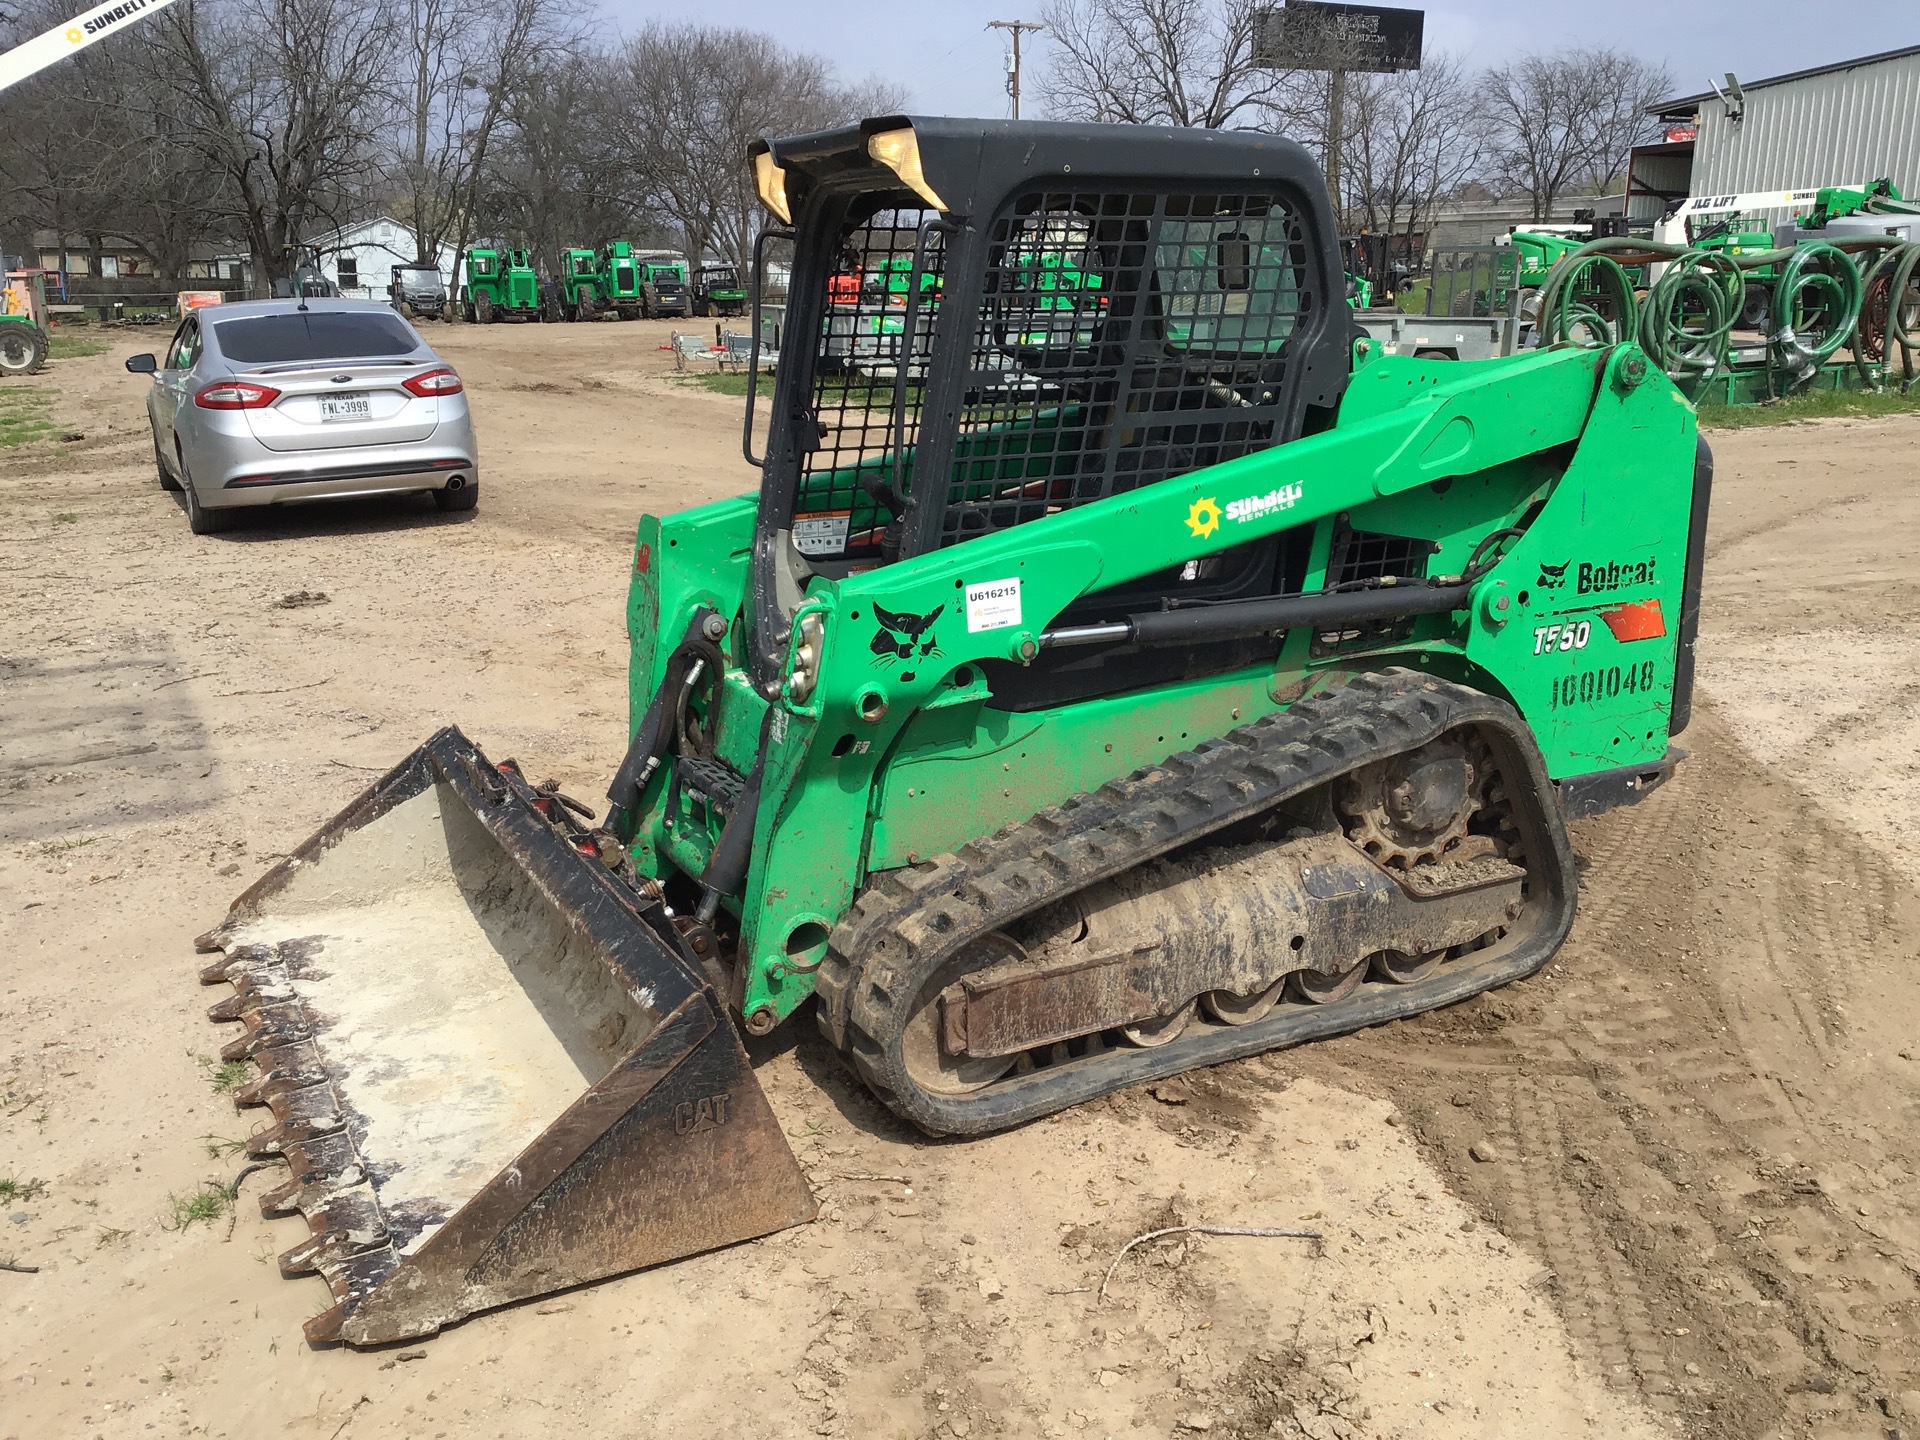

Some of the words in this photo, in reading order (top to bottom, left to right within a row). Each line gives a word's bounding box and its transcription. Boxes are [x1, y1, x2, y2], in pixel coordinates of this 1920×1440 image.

[1691, 198, 1712, 210] JLG
[1712, 196, 1737, 208] LIFT
[1238, 500, 1295, 524] RENTALS
[970, 586, 1016, 602] U616215
[1533, 619, 1592, 656] T550
[675, 1093, 730, 1136] CAT
